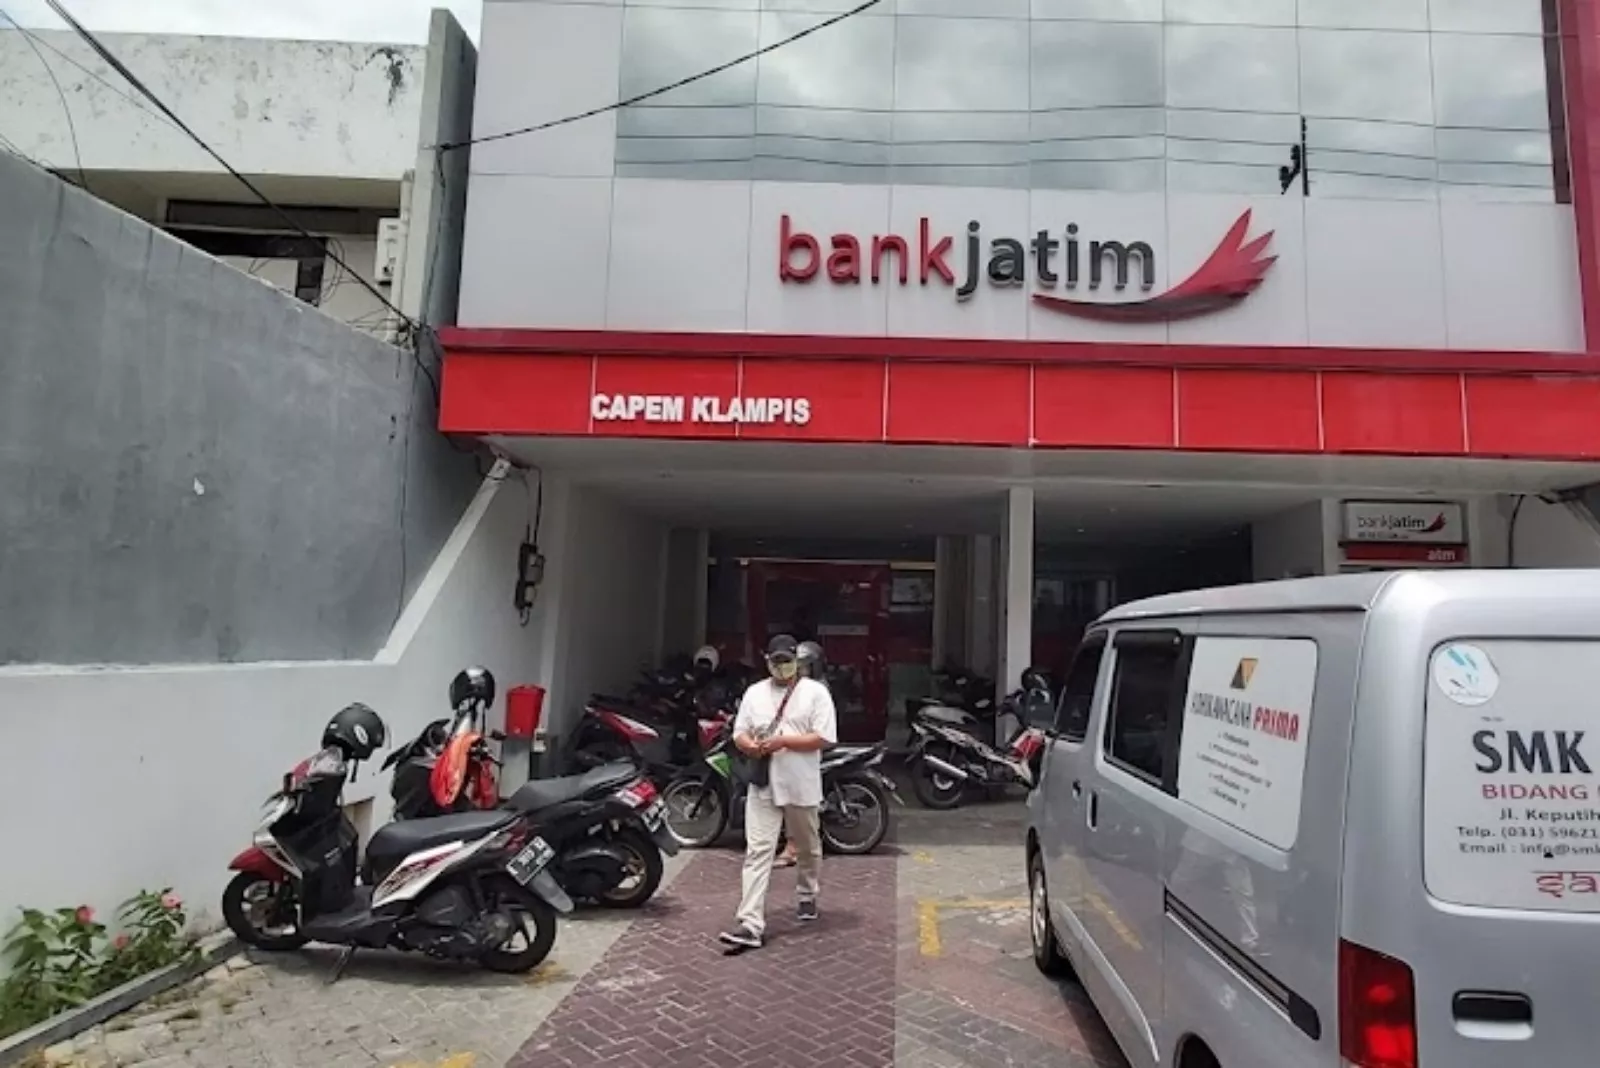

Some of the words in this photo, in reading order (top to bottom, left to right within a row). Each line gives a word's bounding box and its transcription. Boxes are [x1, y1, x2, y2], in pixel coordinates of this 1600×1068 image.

[778, 214, 1157, 301] bankjatim
[591, 394, 684, 422] CAPEM
[692, 397, 811, 424] KLAMPIS
[1357, 514, 1425, 530] bankjatim
[1427, 549, 1456, 561] atm
[1252, 705, 1298, 741] PRIMA
[1472, 730, 1592, 773] SMK
[1482, 784, 1589, 800] BIDANG
[1457, 826, 1496, 839] Telp.
[1501, 825, 1544, 839] (031)
[1459, 843, 1506, 854] Email
